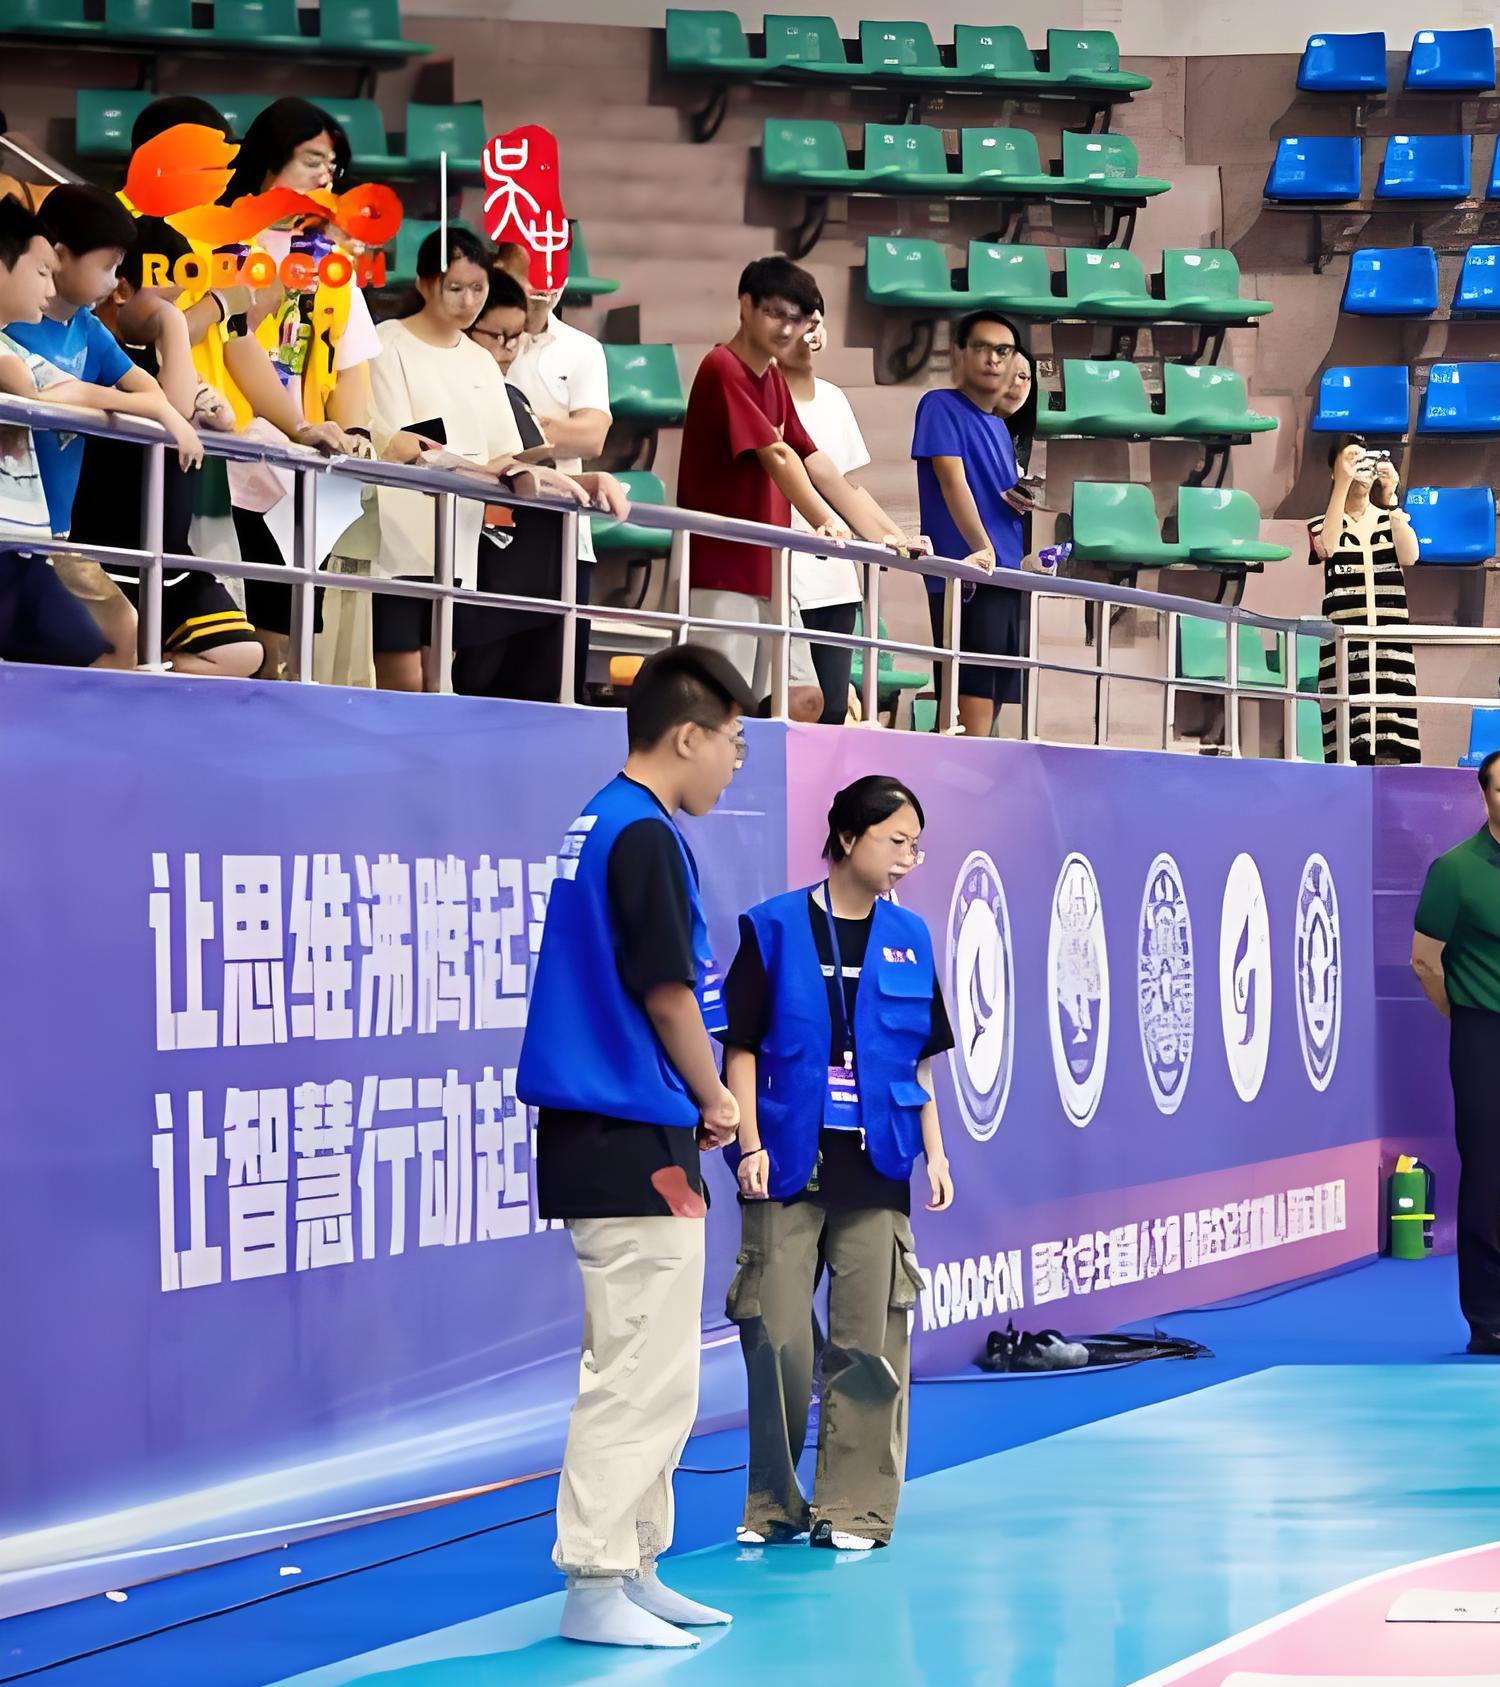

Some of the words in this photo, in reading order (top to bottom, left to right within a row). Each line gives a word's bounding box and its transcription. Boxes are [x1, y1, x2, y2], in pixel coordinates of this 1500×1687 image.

[152, 1065, 565, 1293] 让智慧行动起
